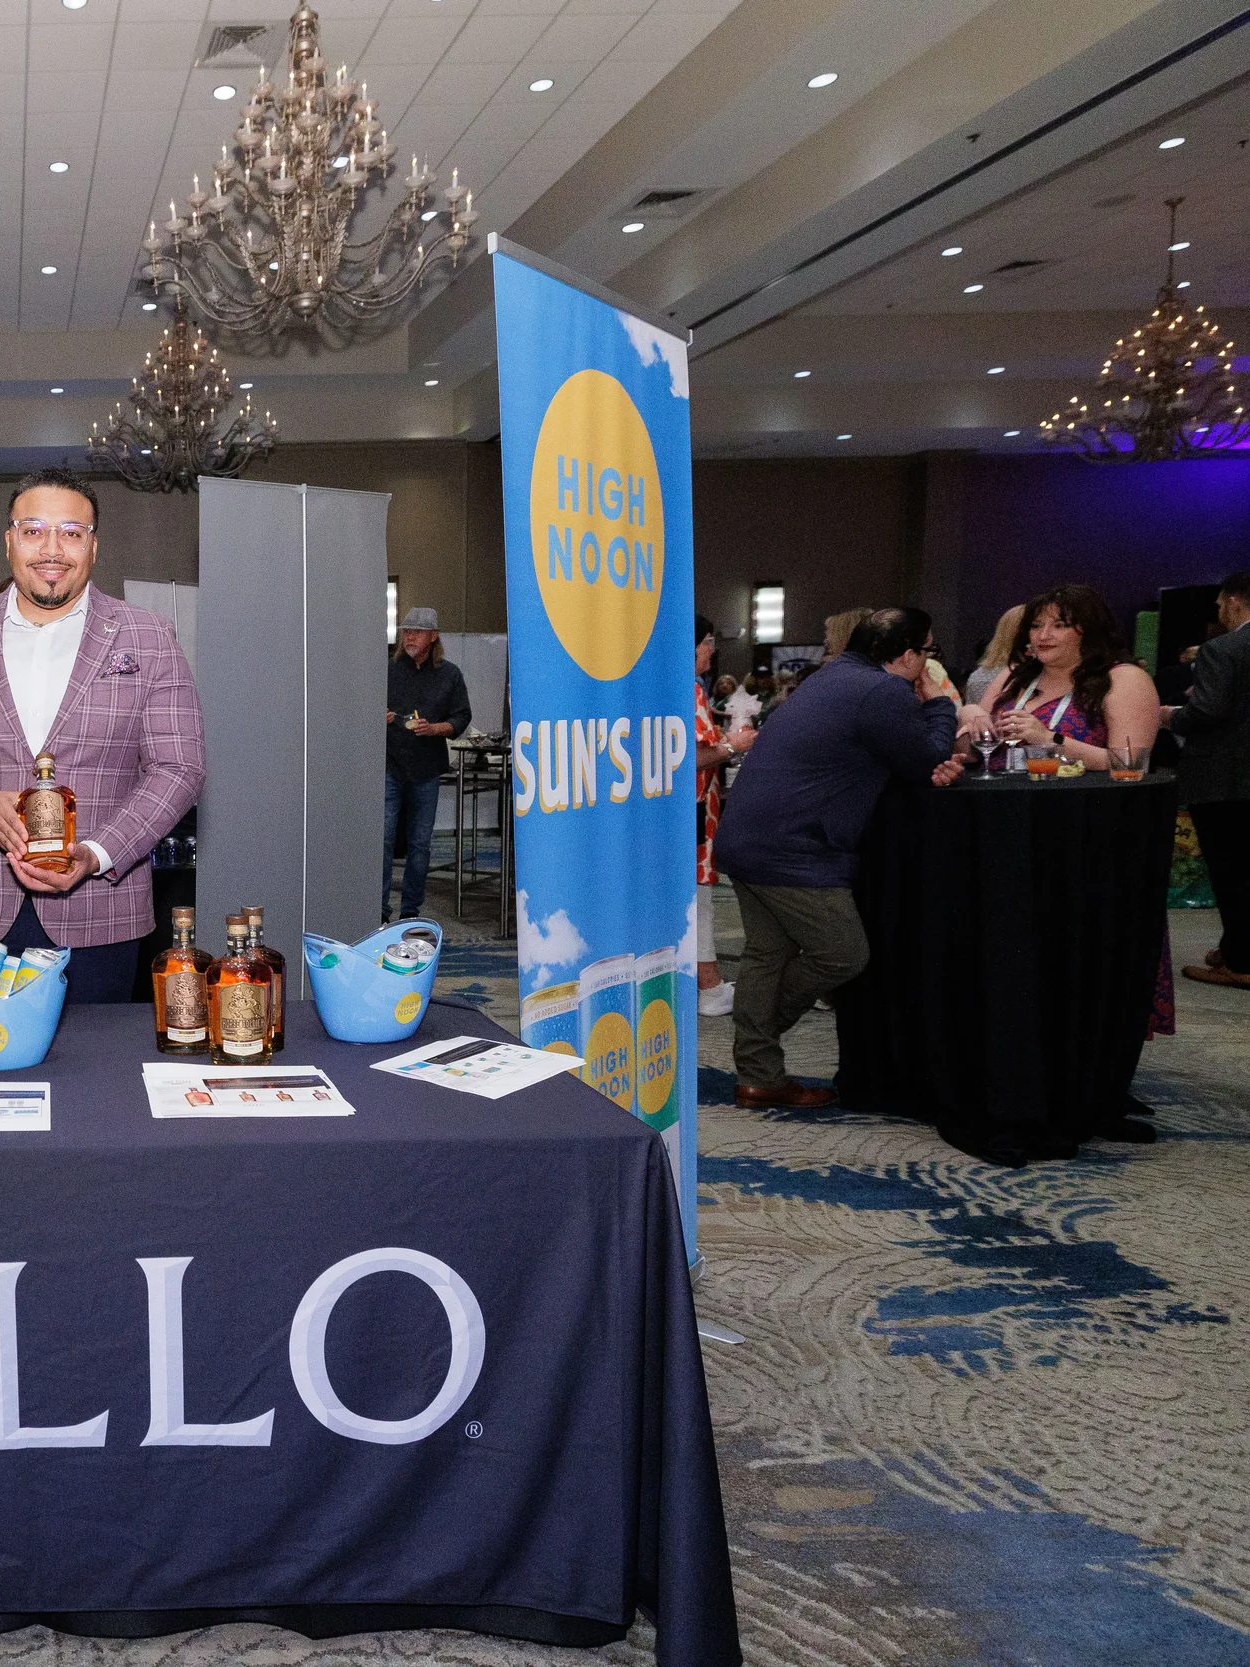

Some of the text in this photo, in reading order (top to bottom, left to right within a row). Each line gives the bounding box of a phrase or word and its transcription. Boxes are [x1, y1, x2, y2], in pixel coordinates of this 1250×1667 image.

[556, 455, 645, 527] HIGH
[547, 524, 653, 592] NOON
[514, 715, 687, 818] SUN'S UP
[639, 1029, 671, 1061] HIGH
[590, 1046, 629, 1082] HIGH
[639, 1053, 672, 1086] NOON
[597, 1072, 631, 1099] OON
